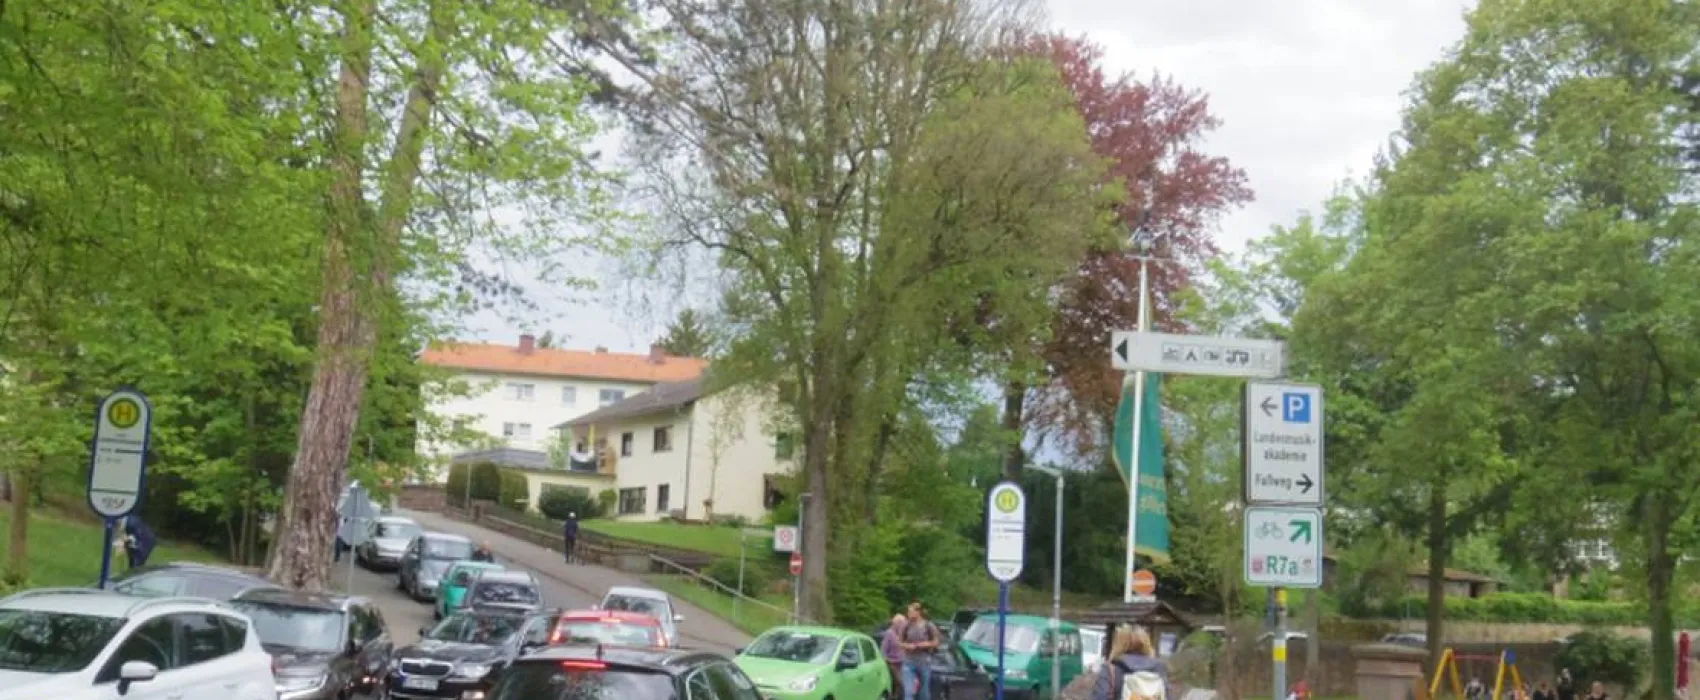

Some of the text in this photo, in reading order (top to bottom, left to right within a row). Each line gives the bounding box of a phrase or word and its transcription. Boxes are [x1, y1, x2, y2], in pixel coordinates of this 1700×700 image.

[115, 403, 132, 420] H
[1288, 396, 1305, 420] P
[1267, 555, 1299, 576] R7a
